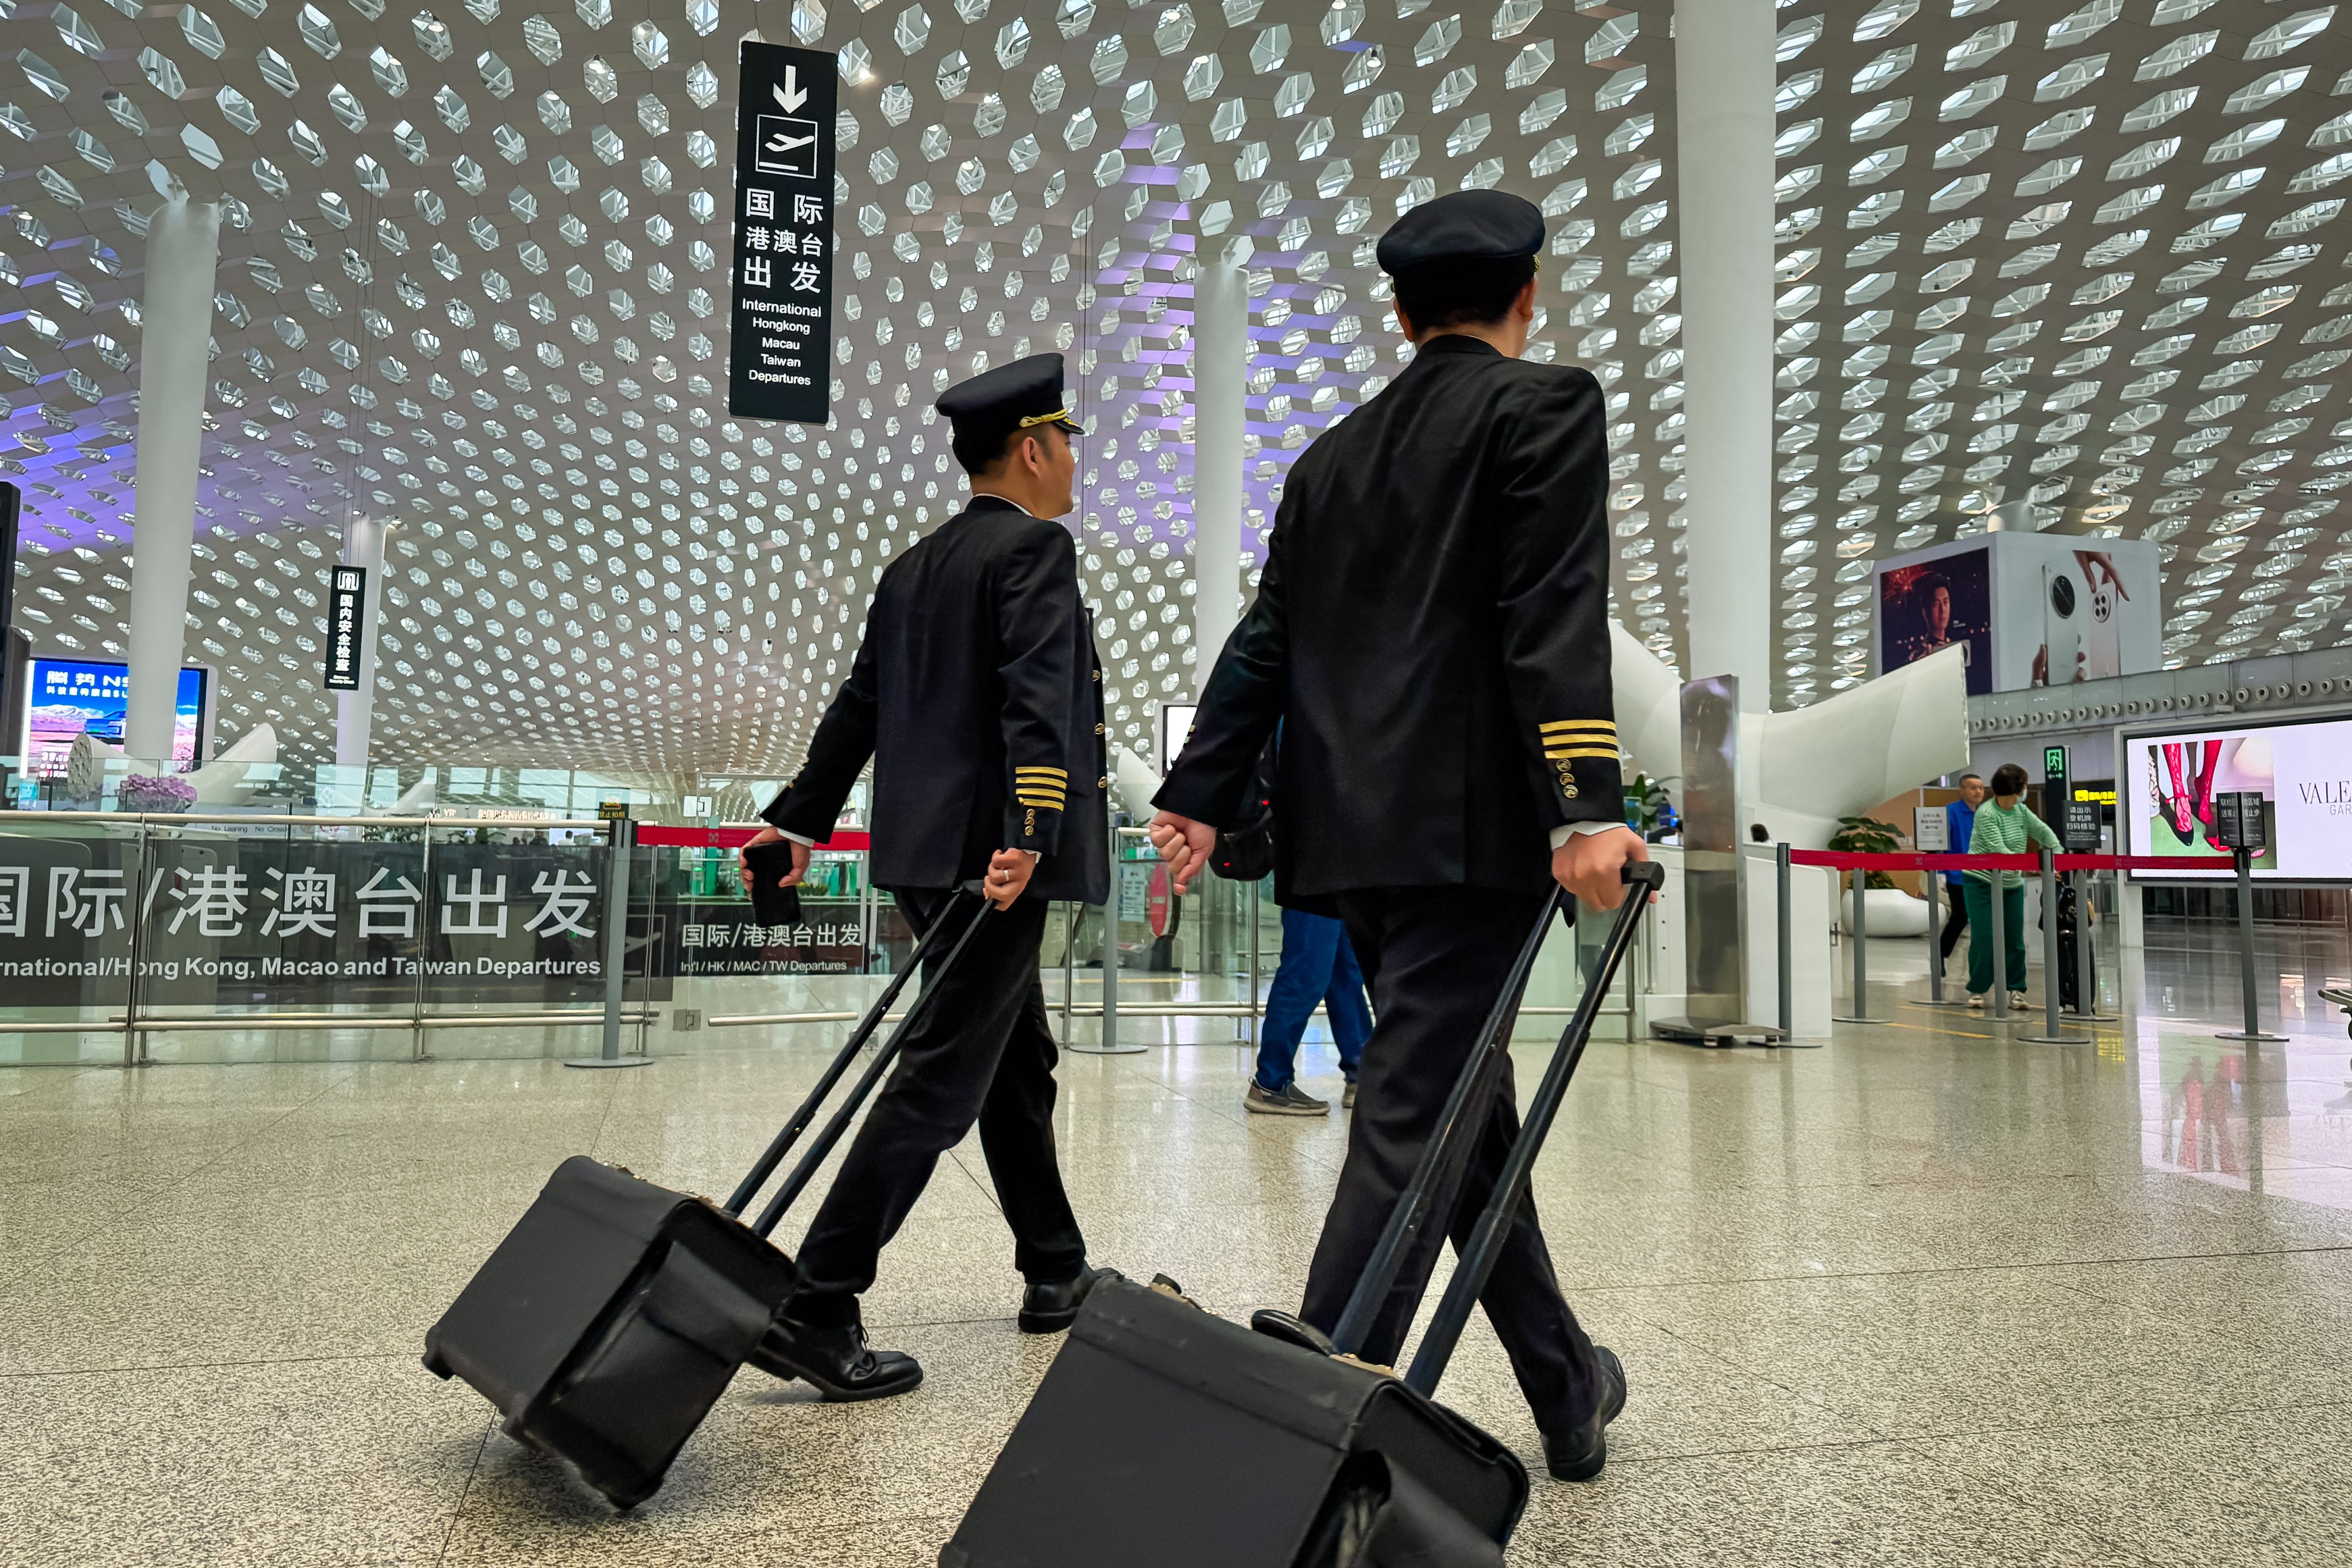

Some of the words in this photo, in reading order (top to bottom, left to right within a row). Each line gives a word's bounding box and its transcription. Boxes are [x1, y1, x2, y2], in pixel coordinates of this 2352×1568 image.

[746, 188, 824, 225] 国际
[746, 226, 823, 257] 港澳台
[744, 256, 821, 293] 出发
[742, 298, 822, 318] International
[752, 316, 811, 335] Hongkong
[762, 337, 800, 350] Macau
[760, 353, 801, 368] Taiwan
[748, 369, 811, 385] Departures
[2298, 781, 2351, 805] VALE
[2330, 804, 2352, 816] GAR
[681, 922, 863, 948] 国际/港澳台出发
[185, 957, 256, 981] Kong,
[261, 957, 339, 976] Macao
[343, 957, 387, 975] and
[391, 957, 471, 976] Taiwan
[477, 956, 601, 979] Departures
[708, 960, 725, 972] HK
[733, 961, 761, 972] MAC
[768, 960, 789, 971] TW
[790, 960, 847, 974] Departures
